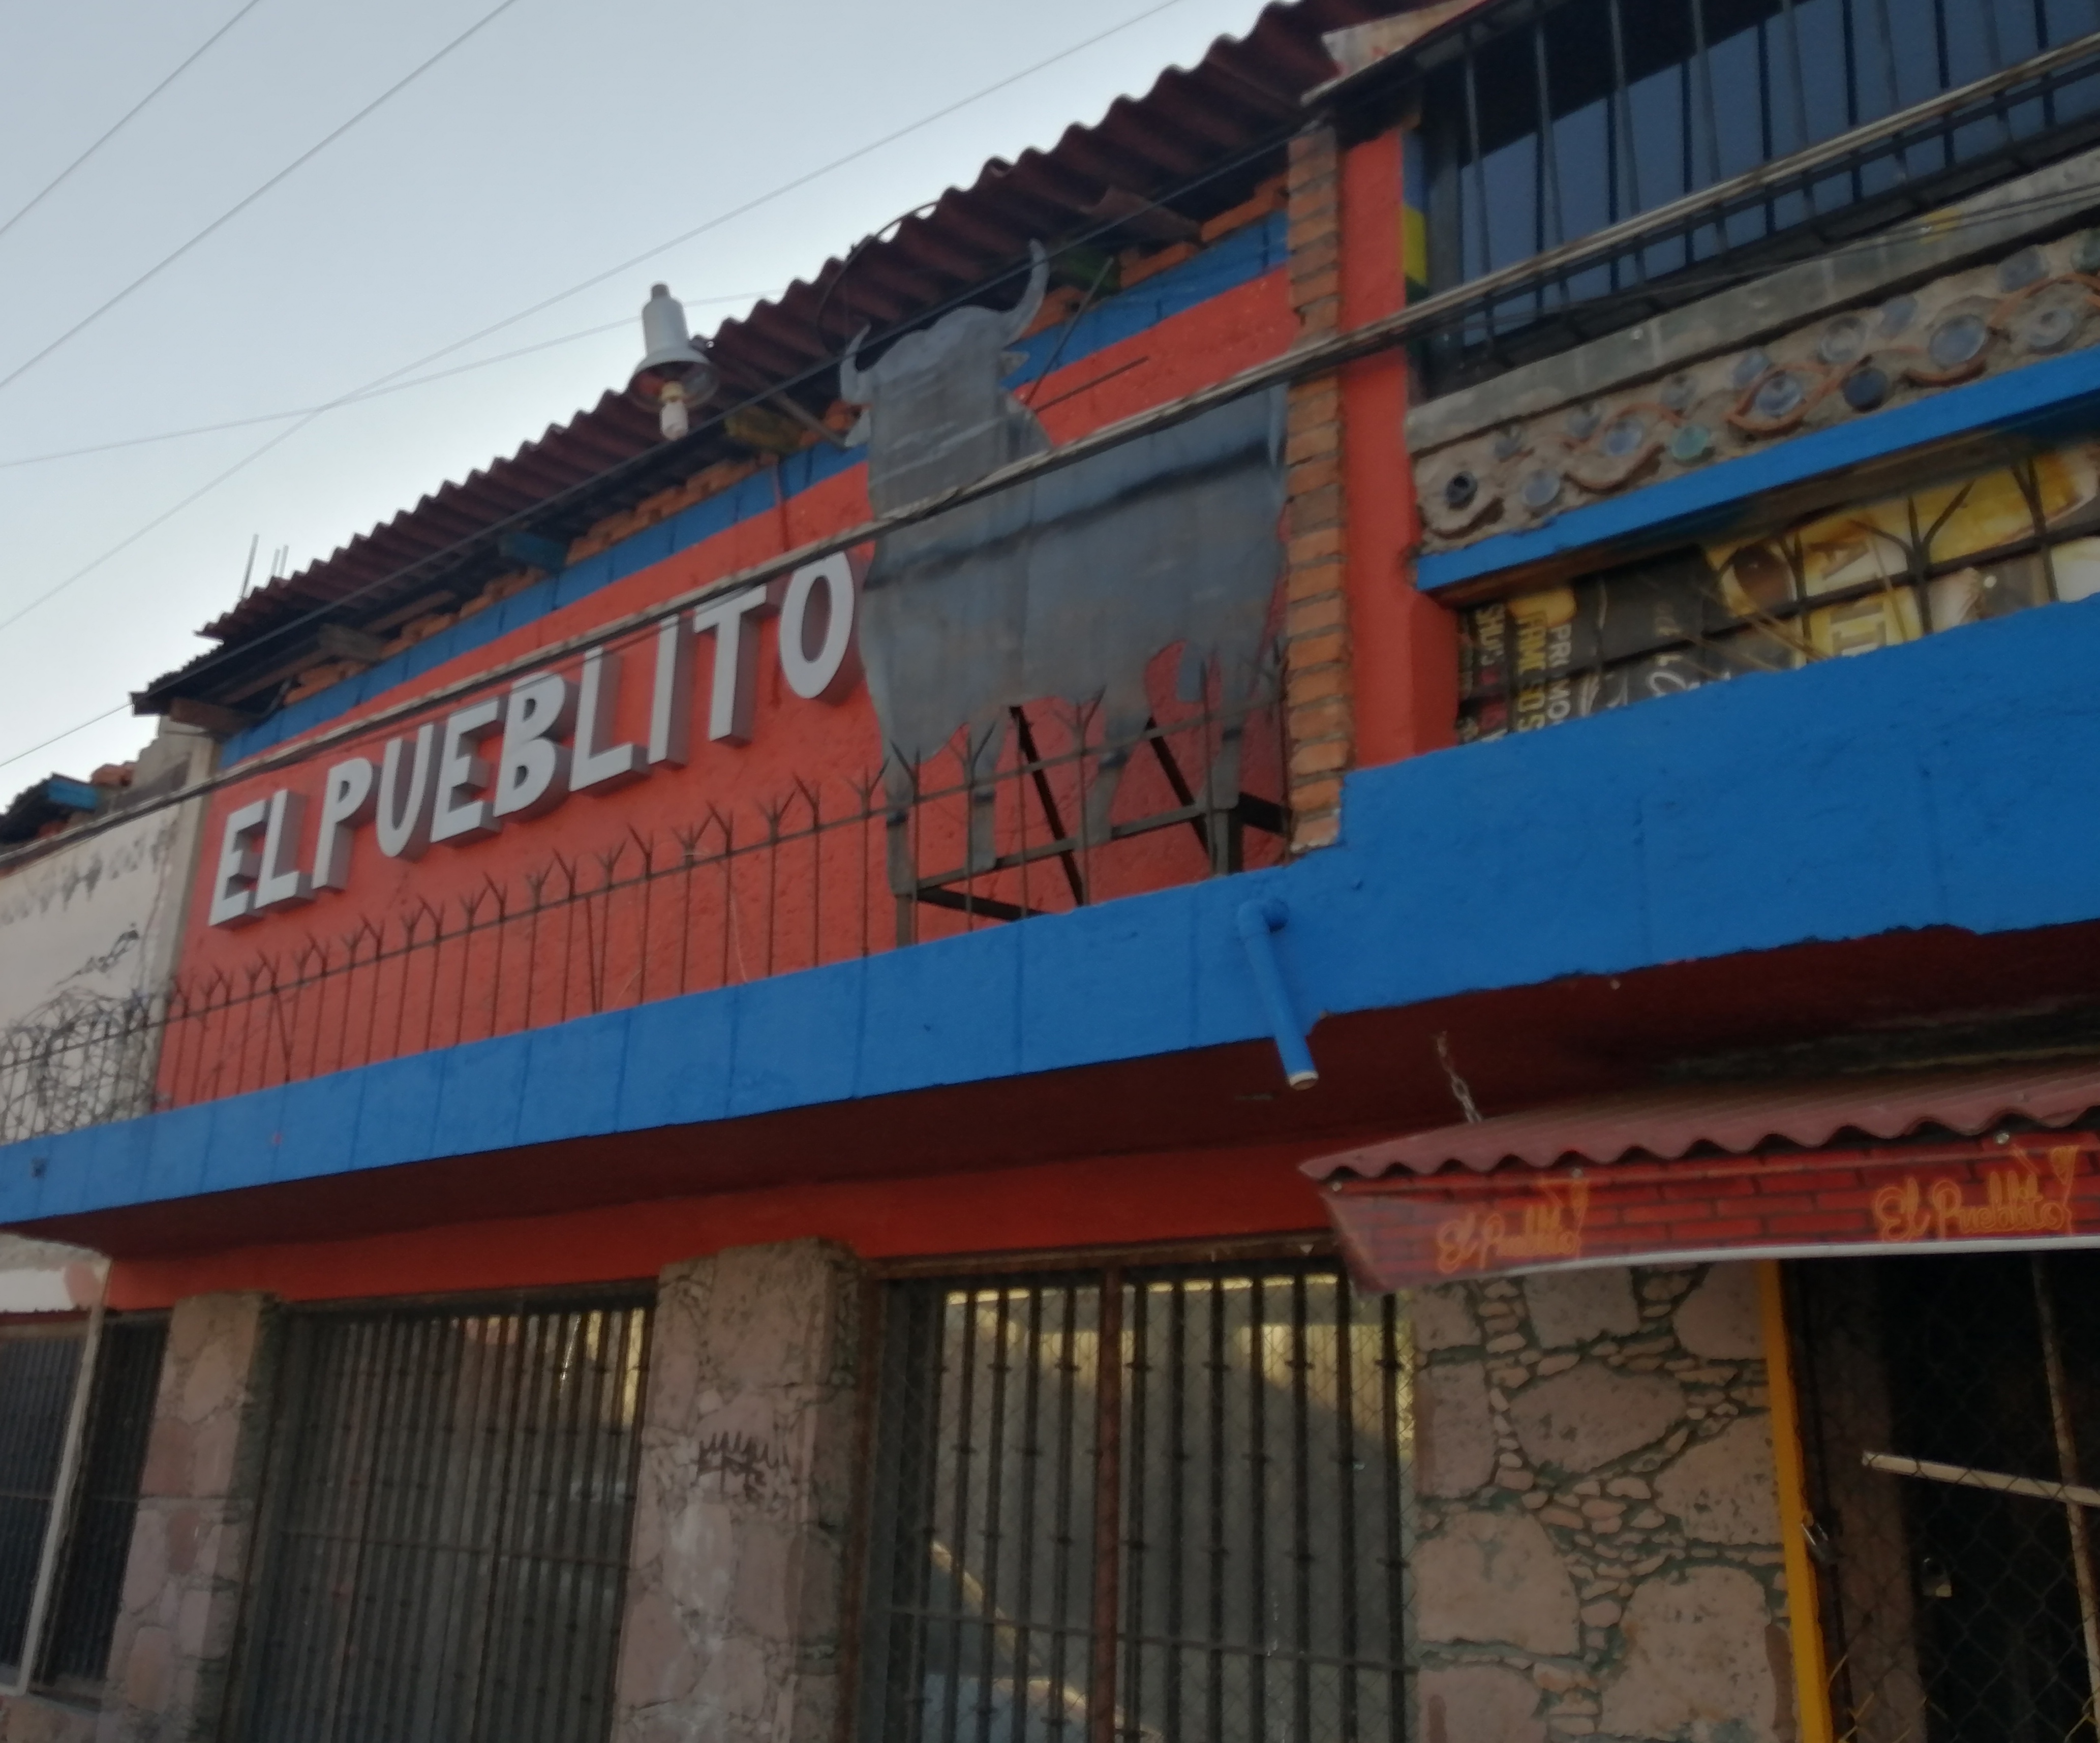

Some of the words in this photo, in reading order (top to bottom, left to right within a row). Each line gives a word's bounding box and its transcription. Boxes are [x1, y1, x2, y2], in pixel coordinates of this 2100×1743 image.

[208, 789, 308, 928] EL
[311, 552, 859, 891] PUEBLITO
[1875, 1176, 1931, 1241] El
[1932, 1171, 2065, 1241] Pueblito
